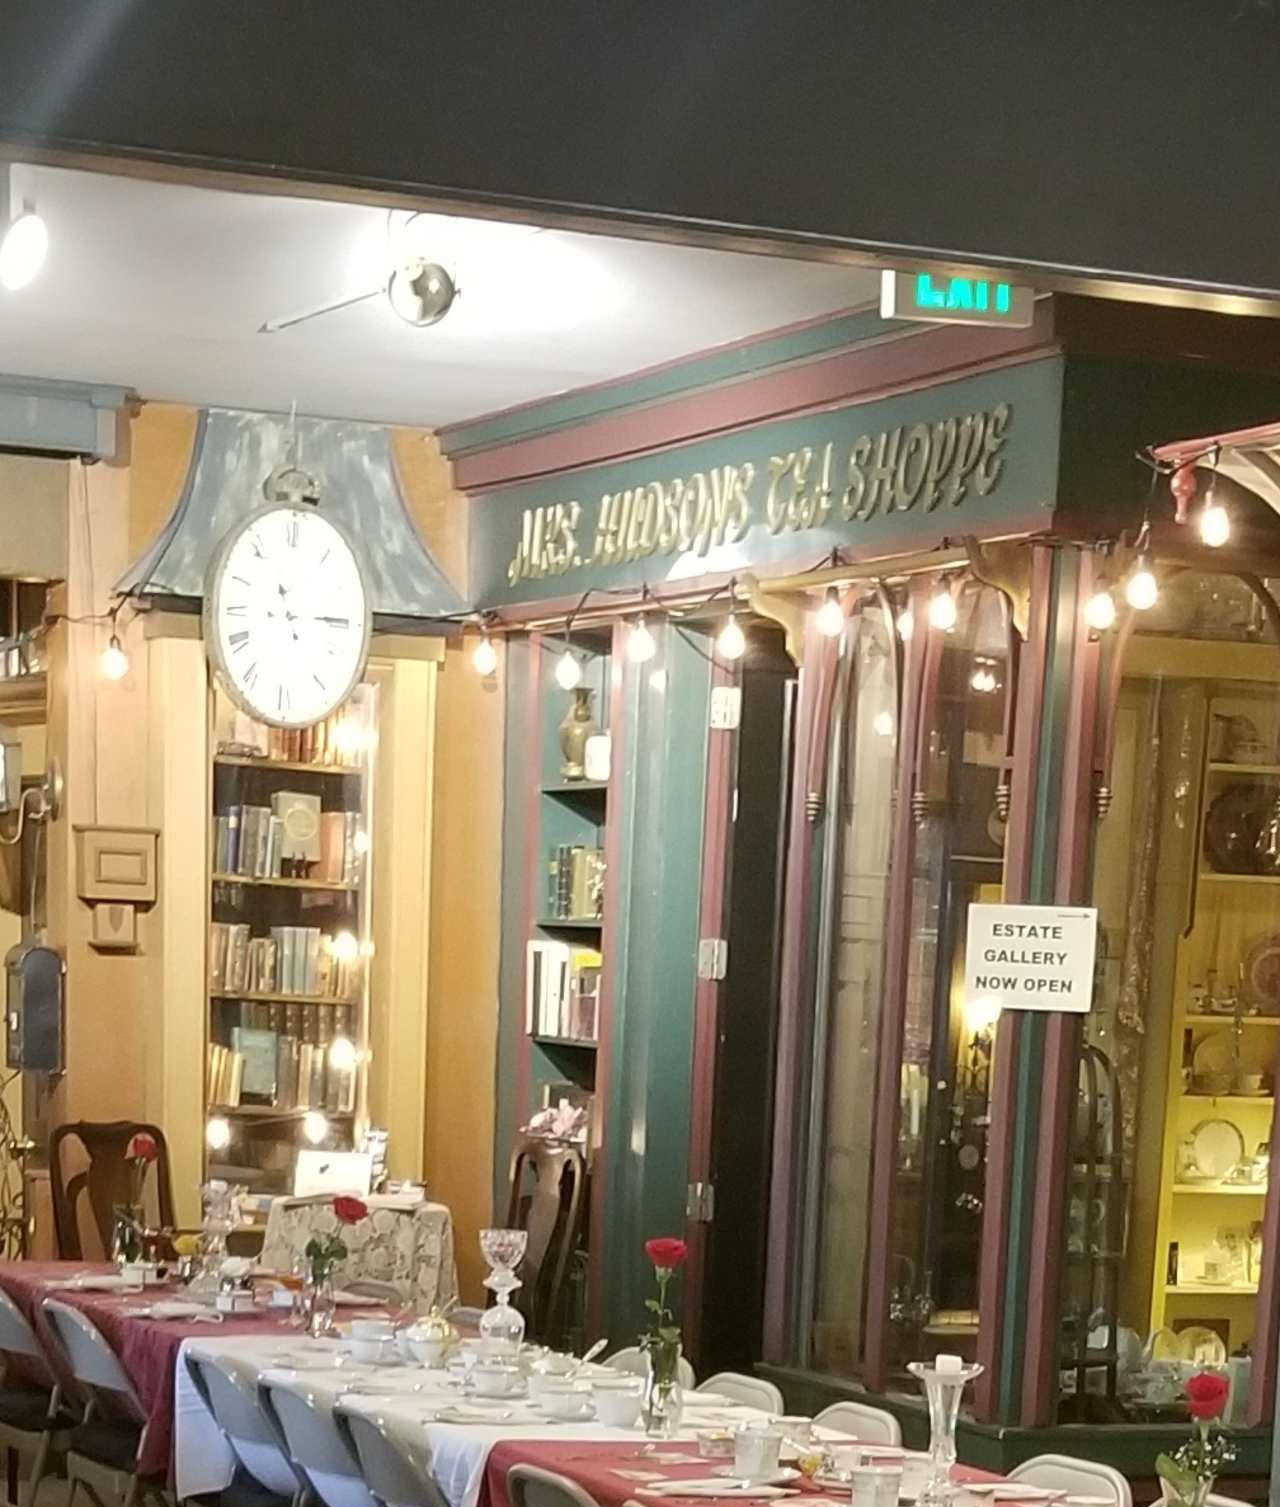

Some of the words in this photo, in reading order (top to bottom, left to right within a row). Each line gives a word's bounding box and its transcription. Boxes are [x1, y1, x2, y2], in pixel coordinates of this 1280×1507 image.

[766, 442, 834, 536] TEA
[842, 402, 1014, 523] SHOPPE
[991, 922, 1064, 940] ESTATE
[983, 948, 1068, 966] GALLERY
[974, 975, 1019, 991] NOW
[1023, 977, 1073, 994] OPEN
